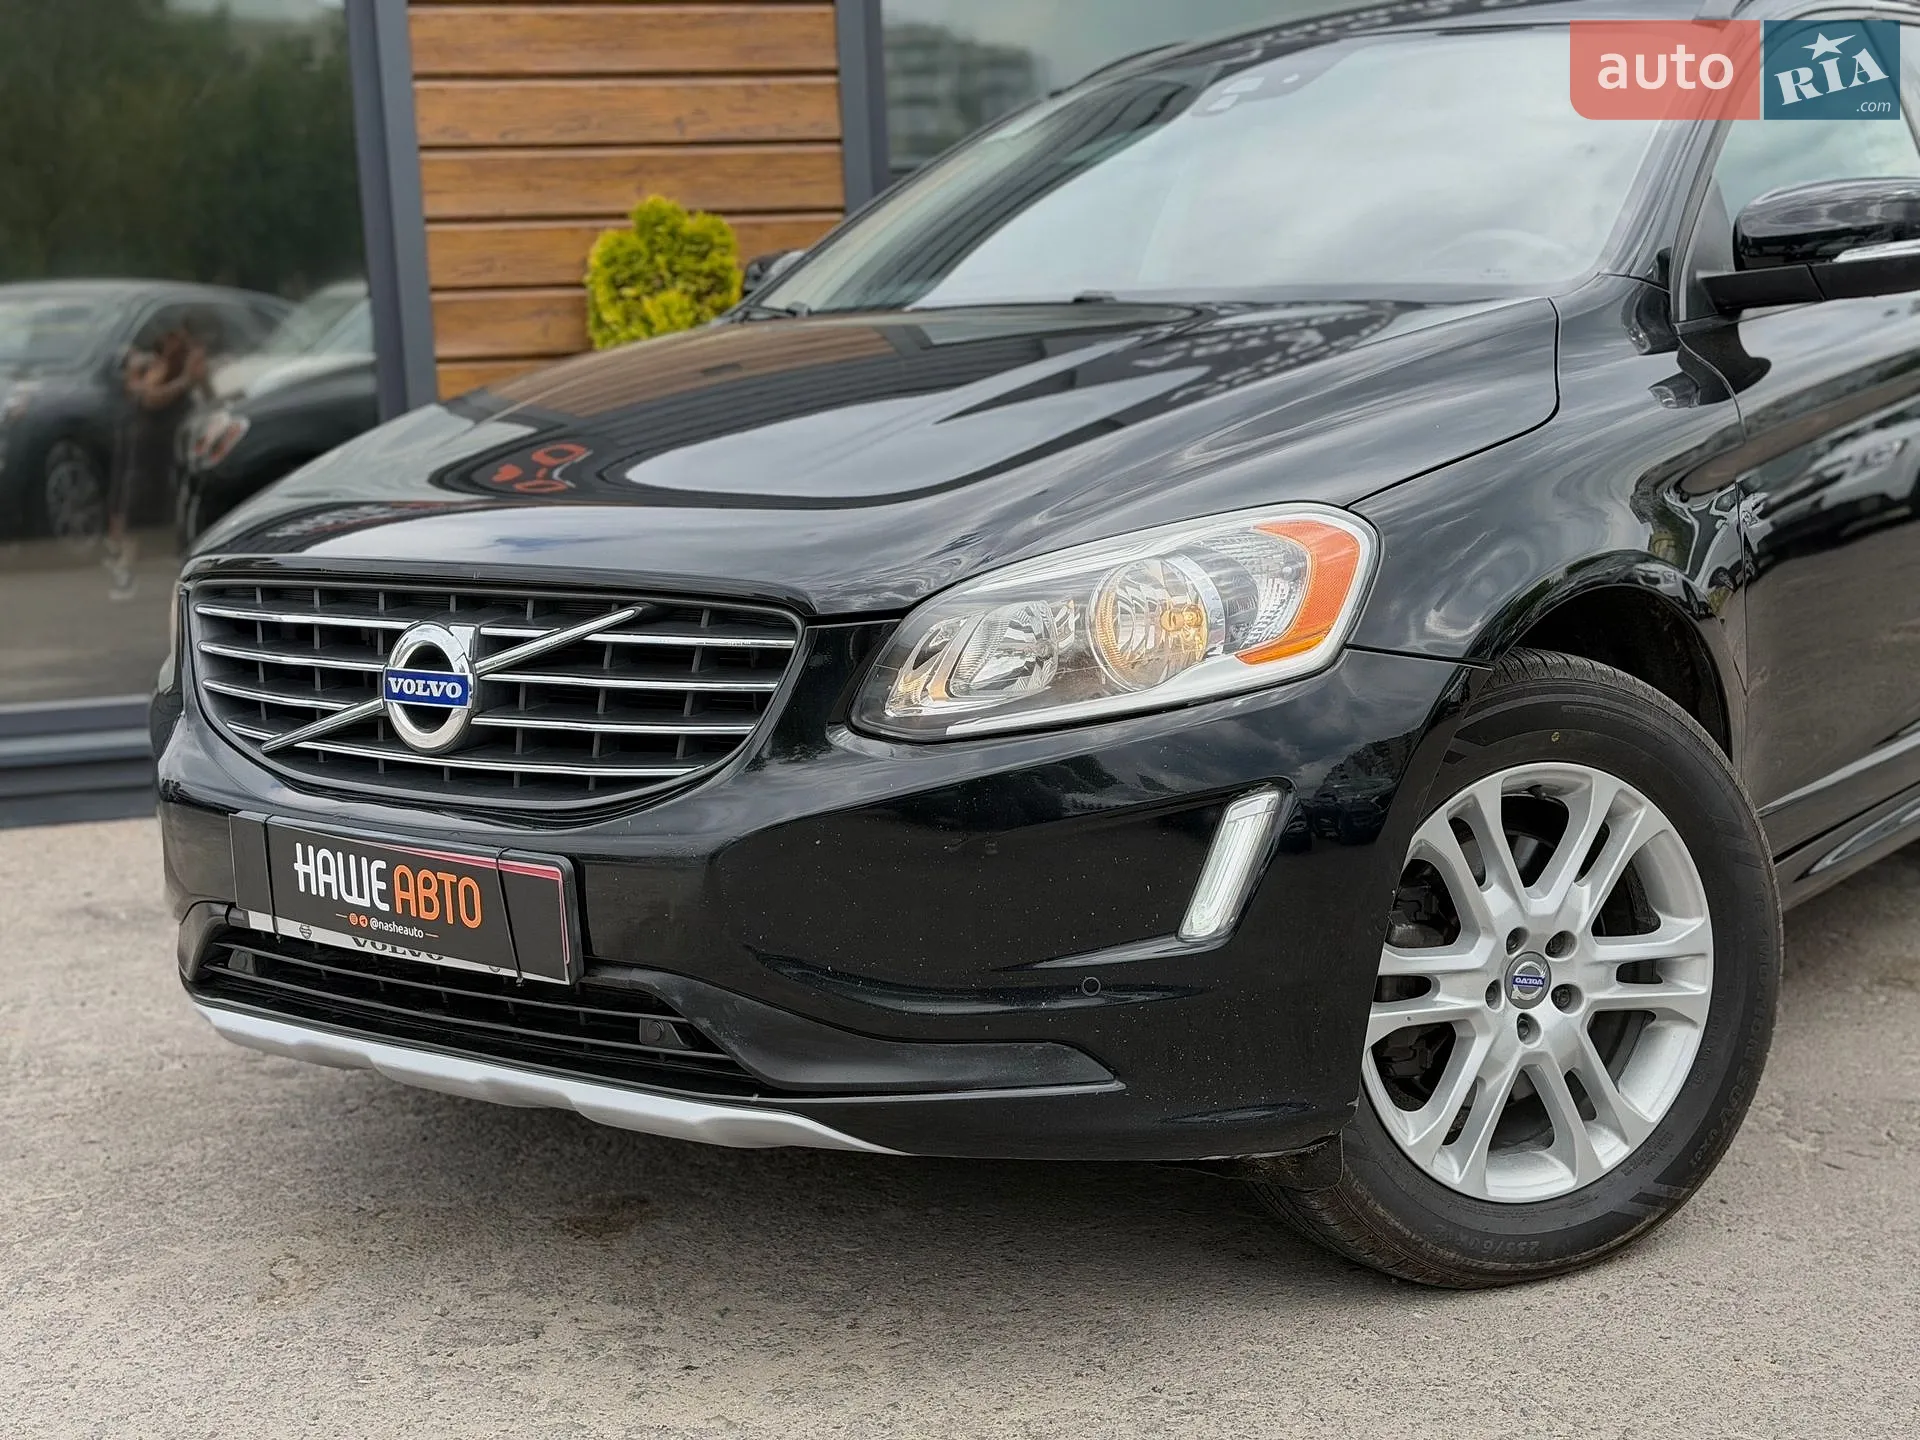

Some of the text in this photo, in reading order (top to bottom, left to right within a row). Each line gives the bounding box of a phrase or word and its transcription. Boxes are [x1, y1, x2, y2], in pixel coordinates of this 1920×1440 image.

[388, 677, 462, 698] VOLVO
[293, 842, 482, 929] НАШЕ АВТО
[369, 917, 424, 939] @nasheauto
[1515, 977, 1543, 985] VOLVO
